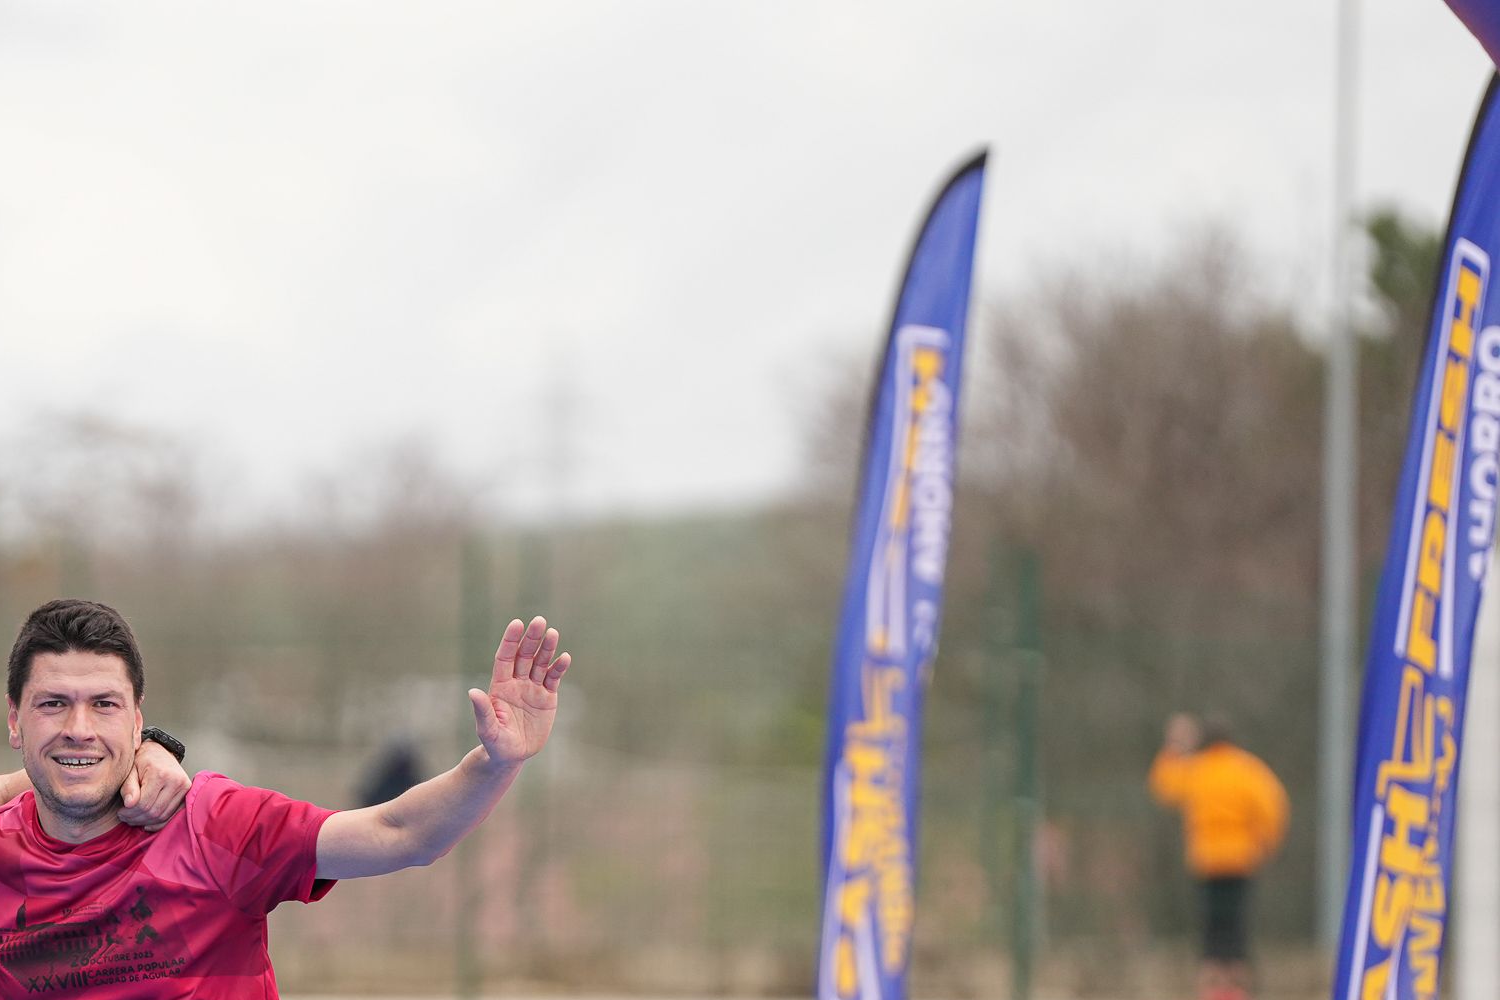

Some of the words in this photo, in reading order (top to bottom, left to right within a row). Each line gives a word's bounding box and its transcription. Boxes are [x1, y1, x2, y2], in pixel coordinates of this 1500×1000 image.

[1406, 265, 1485, 674] FRESH
[28, 970, 88, 994] XXVIII
[88, 966, 135, 979] CARRERA
[137, 957, 185, 972] POPULAR
[129, 974, 140, 983] DE
[142, 967, 181, 981] AGUILAR
